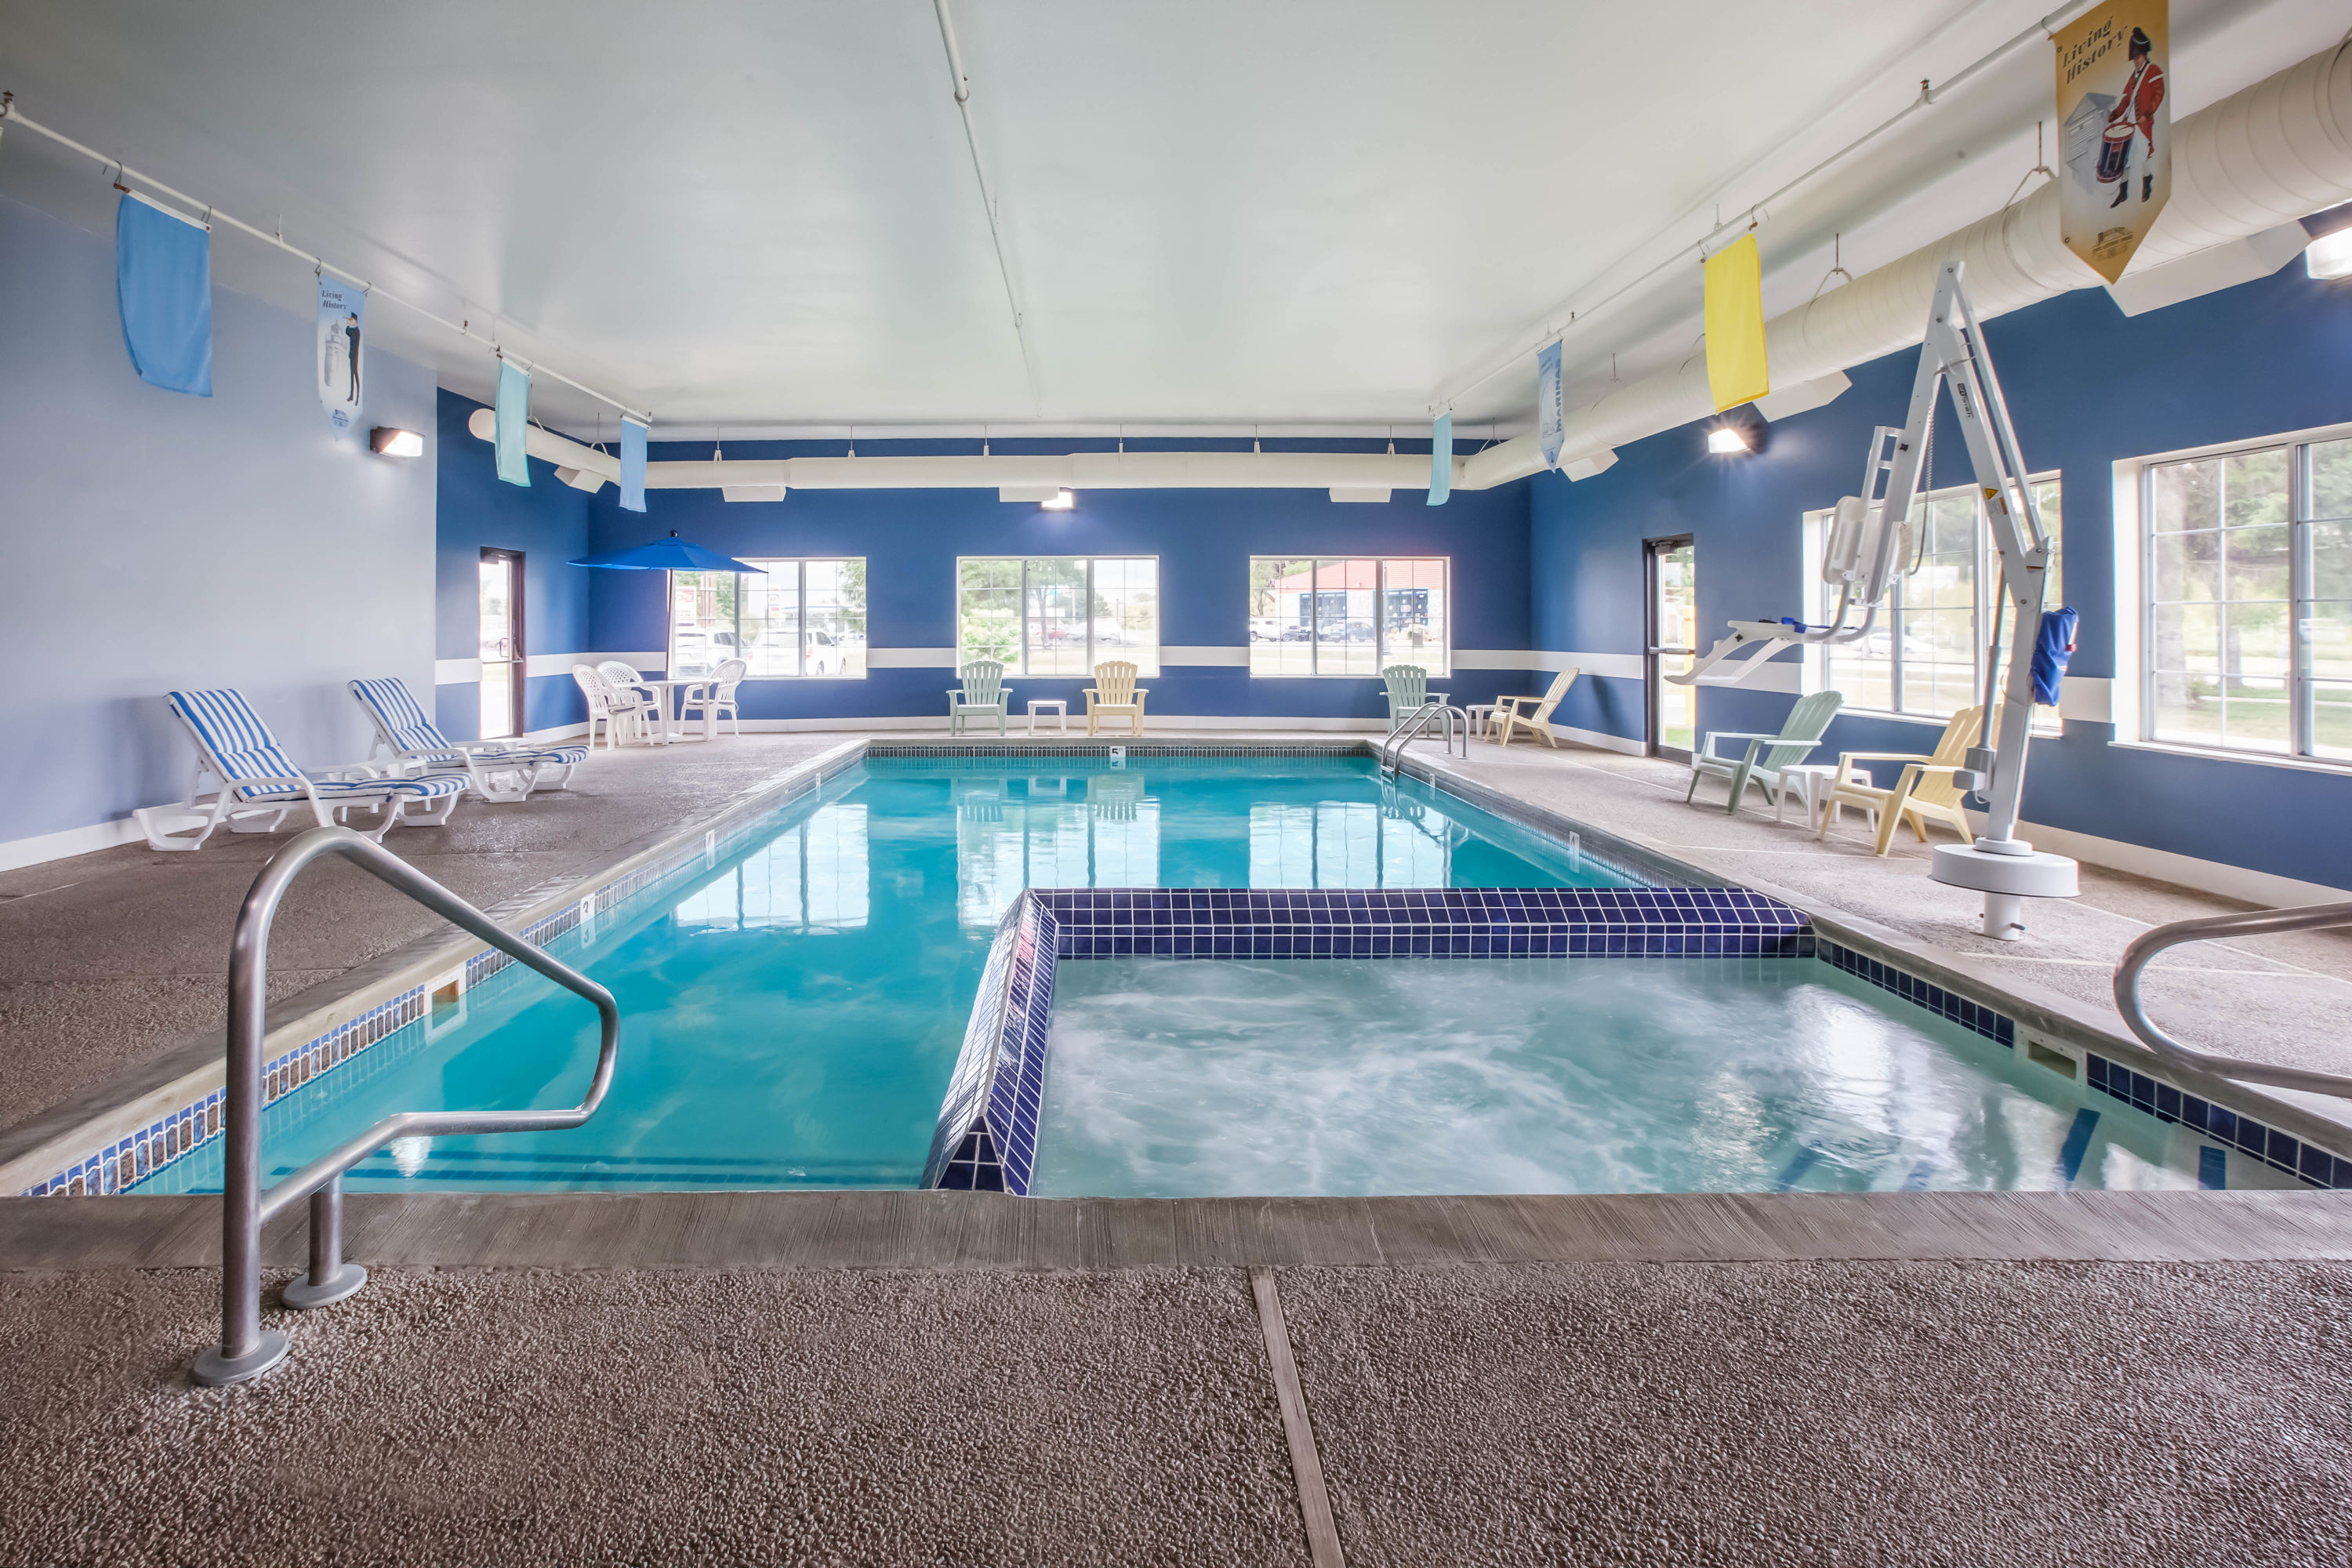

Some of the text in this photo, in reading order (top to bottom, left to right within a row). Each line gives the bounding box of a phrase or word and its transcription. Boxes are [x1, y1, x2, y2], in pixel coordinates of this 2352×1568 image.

[2063, 16, 2113, 68] Living
[2067, 25, 2128, 85] History
[321, 289, 343, 301] Living
[322, 299, 347, 310] History
